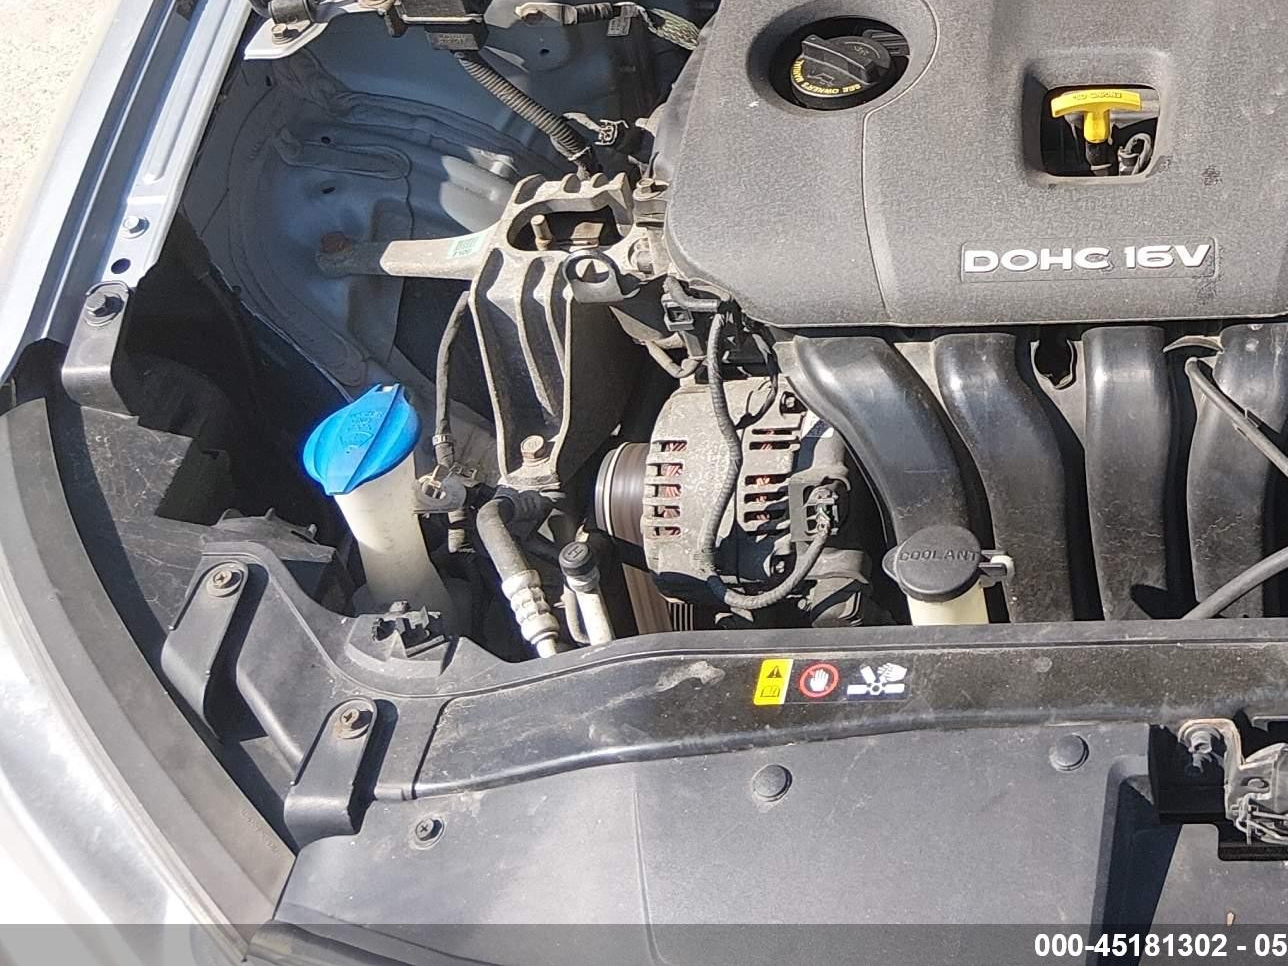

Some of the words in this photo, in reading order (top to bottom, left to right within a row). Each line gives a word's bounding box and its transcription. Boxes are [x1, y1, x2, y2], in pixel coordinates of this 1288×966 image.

[964, 246, 1111, 273] DOHC
[1123, 244, 1211, 269] 16V
[900, 549, 980, 562] COOLANT
